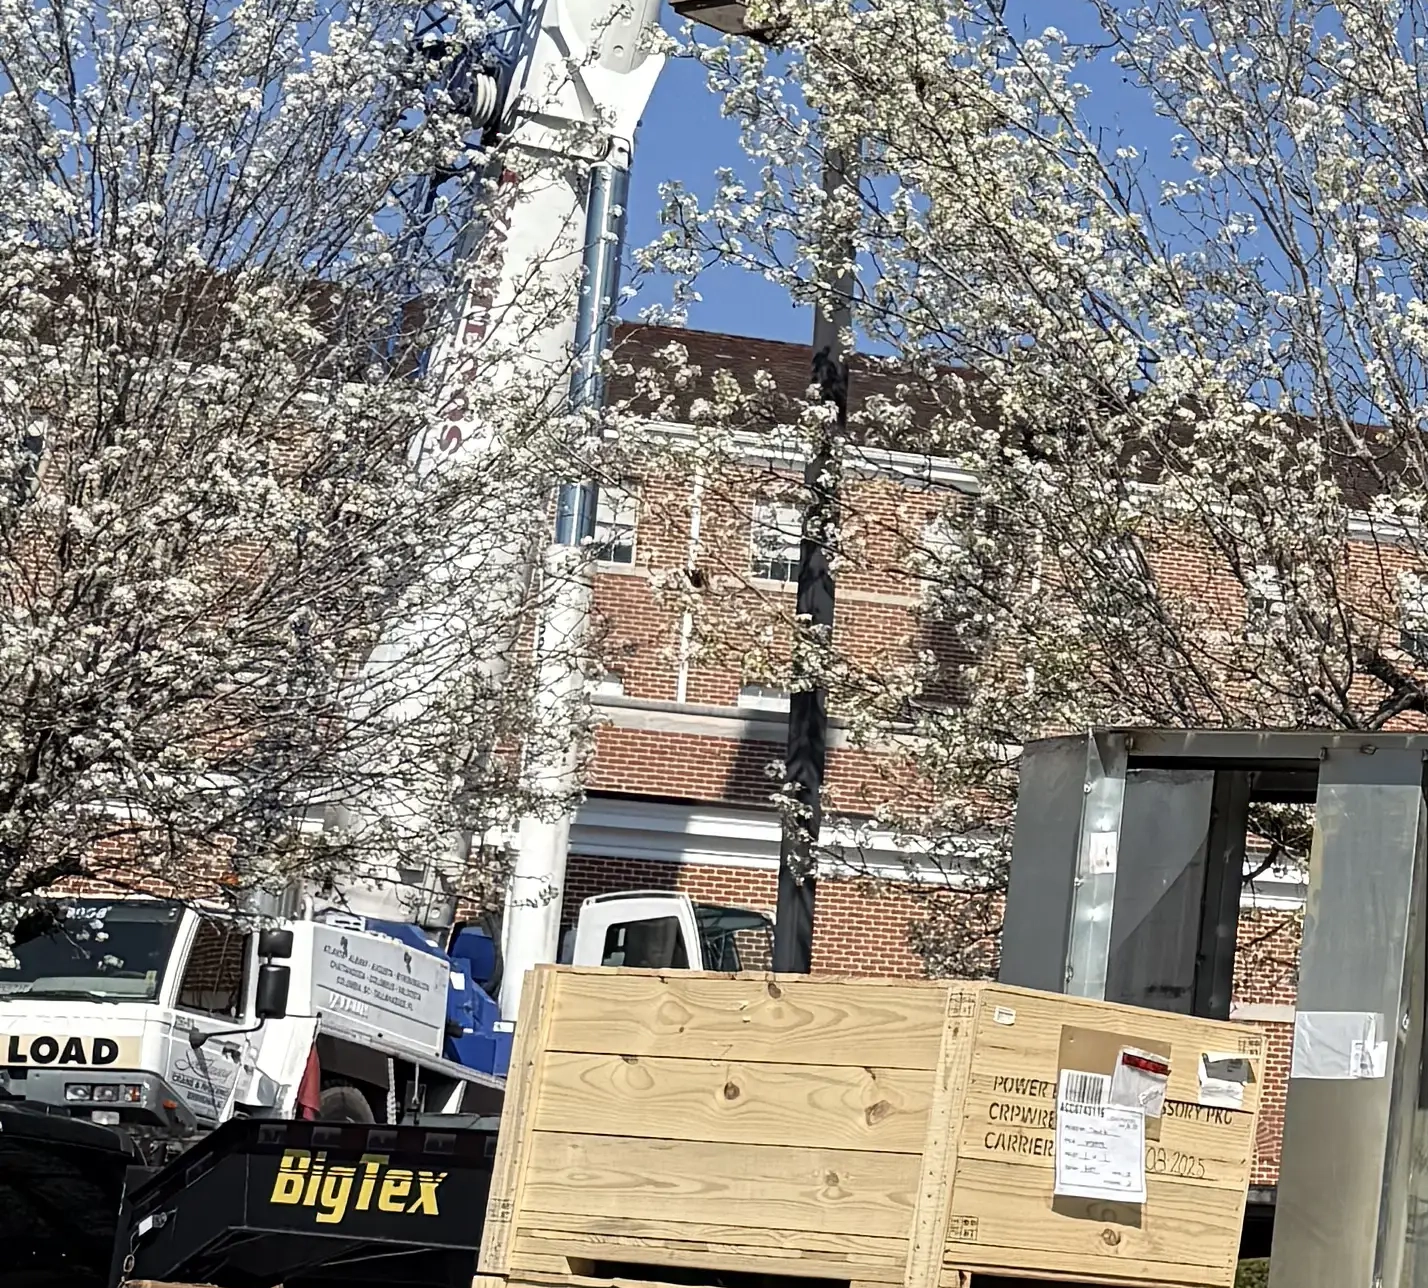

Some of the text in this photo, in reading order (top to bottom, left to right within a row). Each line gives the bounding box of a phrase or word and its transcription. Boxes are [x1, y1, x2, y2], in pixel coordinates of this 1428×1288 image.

[8, 1036, 119, 1066] LOAD
[993, 1075, 1048, 1098] POWER
[989, 1102, 1056, 1130] CRPWRE
[984, 1131, 1055, 1157] CARRIER
[270, 1148, 448, 1224] BigTex
